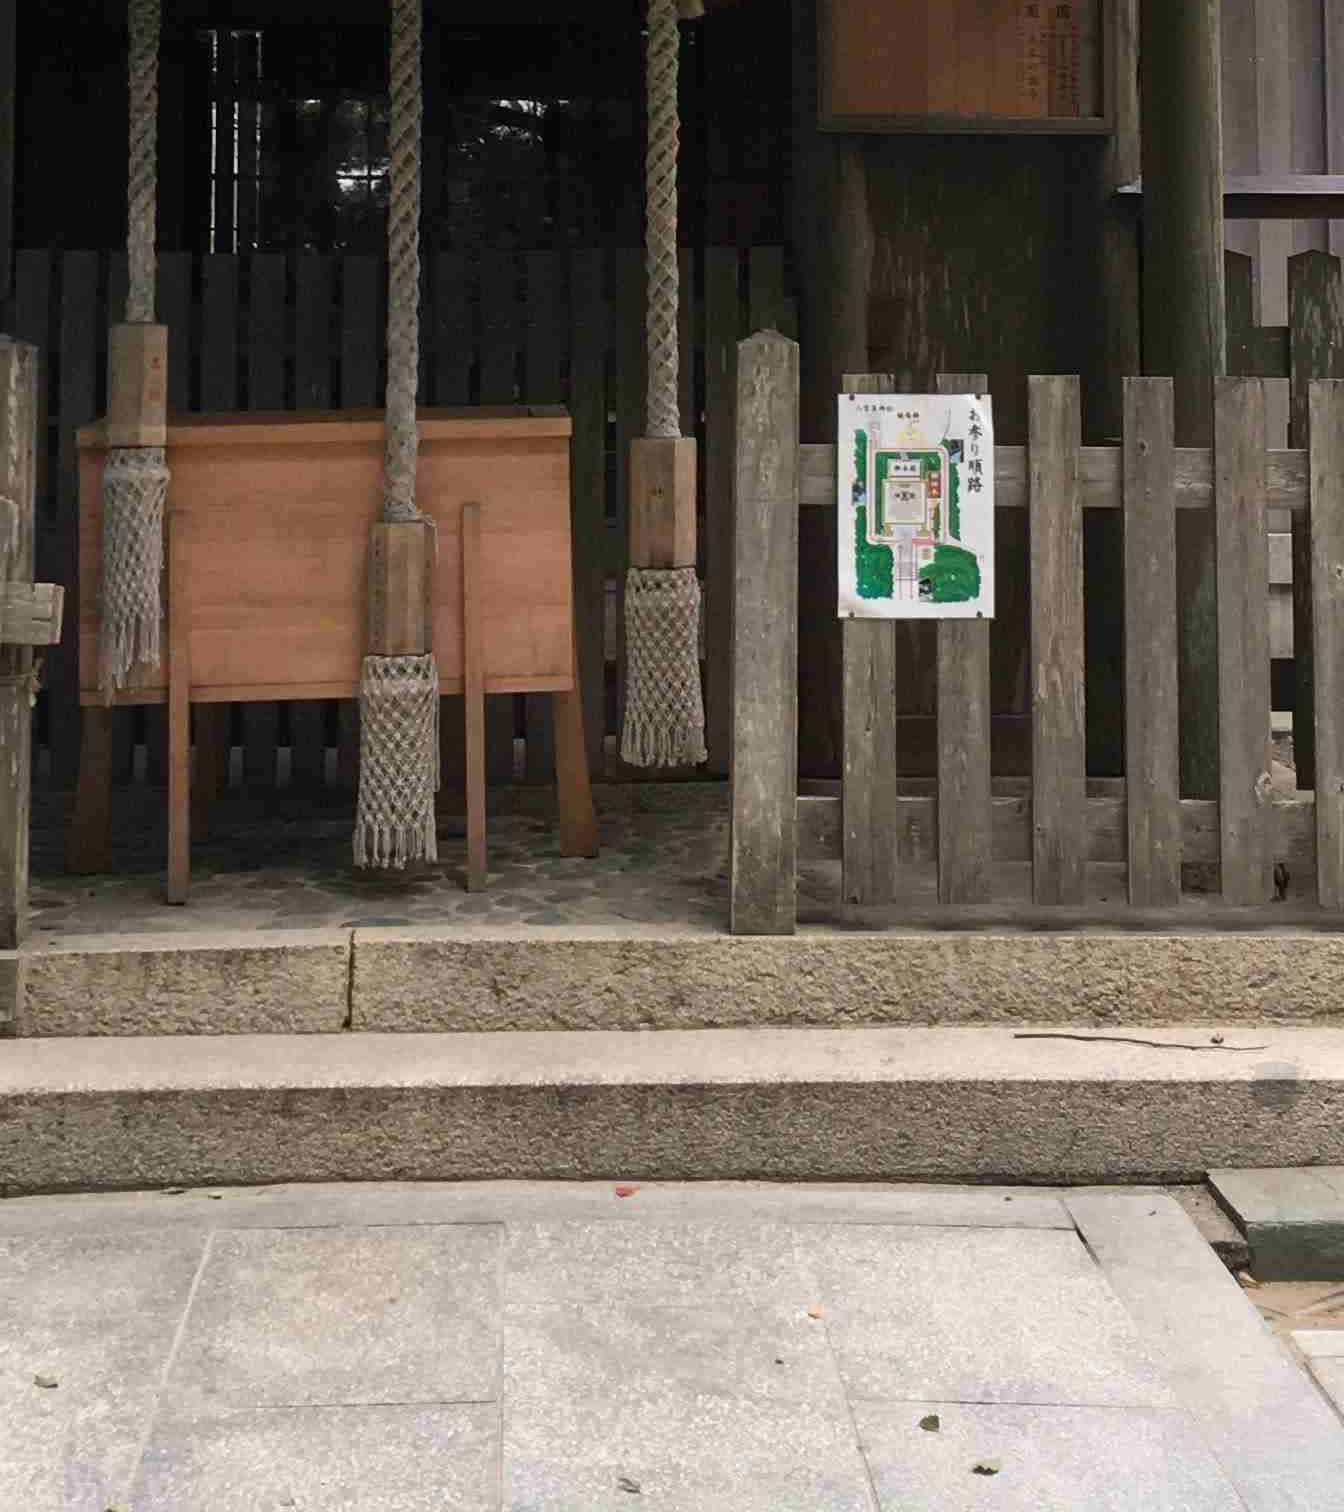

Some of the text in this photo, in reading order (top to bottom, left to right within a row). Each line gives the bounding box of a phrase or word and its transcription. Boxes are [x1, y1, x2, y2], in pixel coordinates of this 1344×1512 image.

[966, 408, 984, 493] お参り順路
